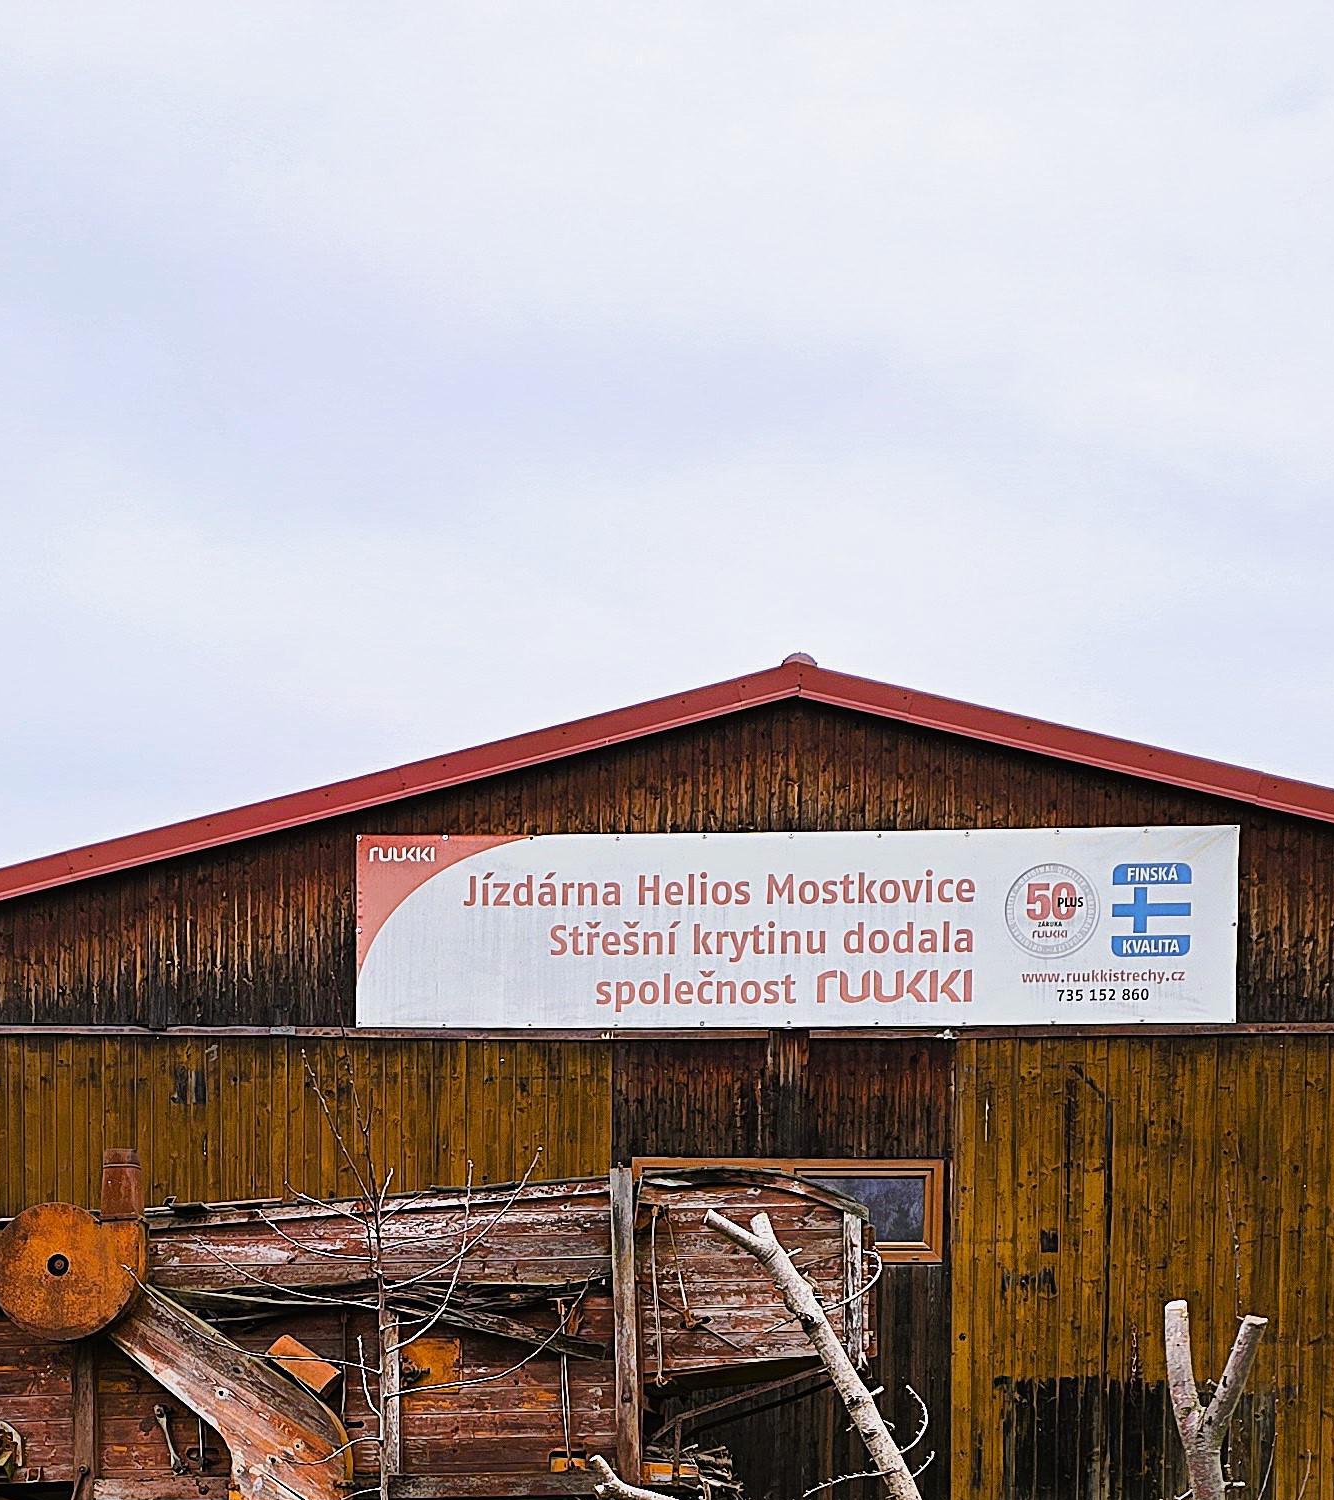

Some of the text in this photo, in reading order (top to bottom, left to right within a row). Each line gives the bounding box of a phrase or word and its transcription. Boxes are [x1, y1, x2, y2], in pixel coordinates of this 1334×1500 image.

[1127, 864, 1179, 882] FINSKÁ
[463, 869, 976, 908] Jízdárna Helios Mostkovice
[1026, 881, 1084, 921] 50 PLUS
[550, 921, 974, 963] Střešní krytinu dodala
[1122, 939, 1180, 954] KVALITA
[1022, 969, 1186, 984] www.ruukkistrechy.cz
[596, 970, 797, 1013] společnost
[1057, 988, 1150, 1001] 735 152 860
